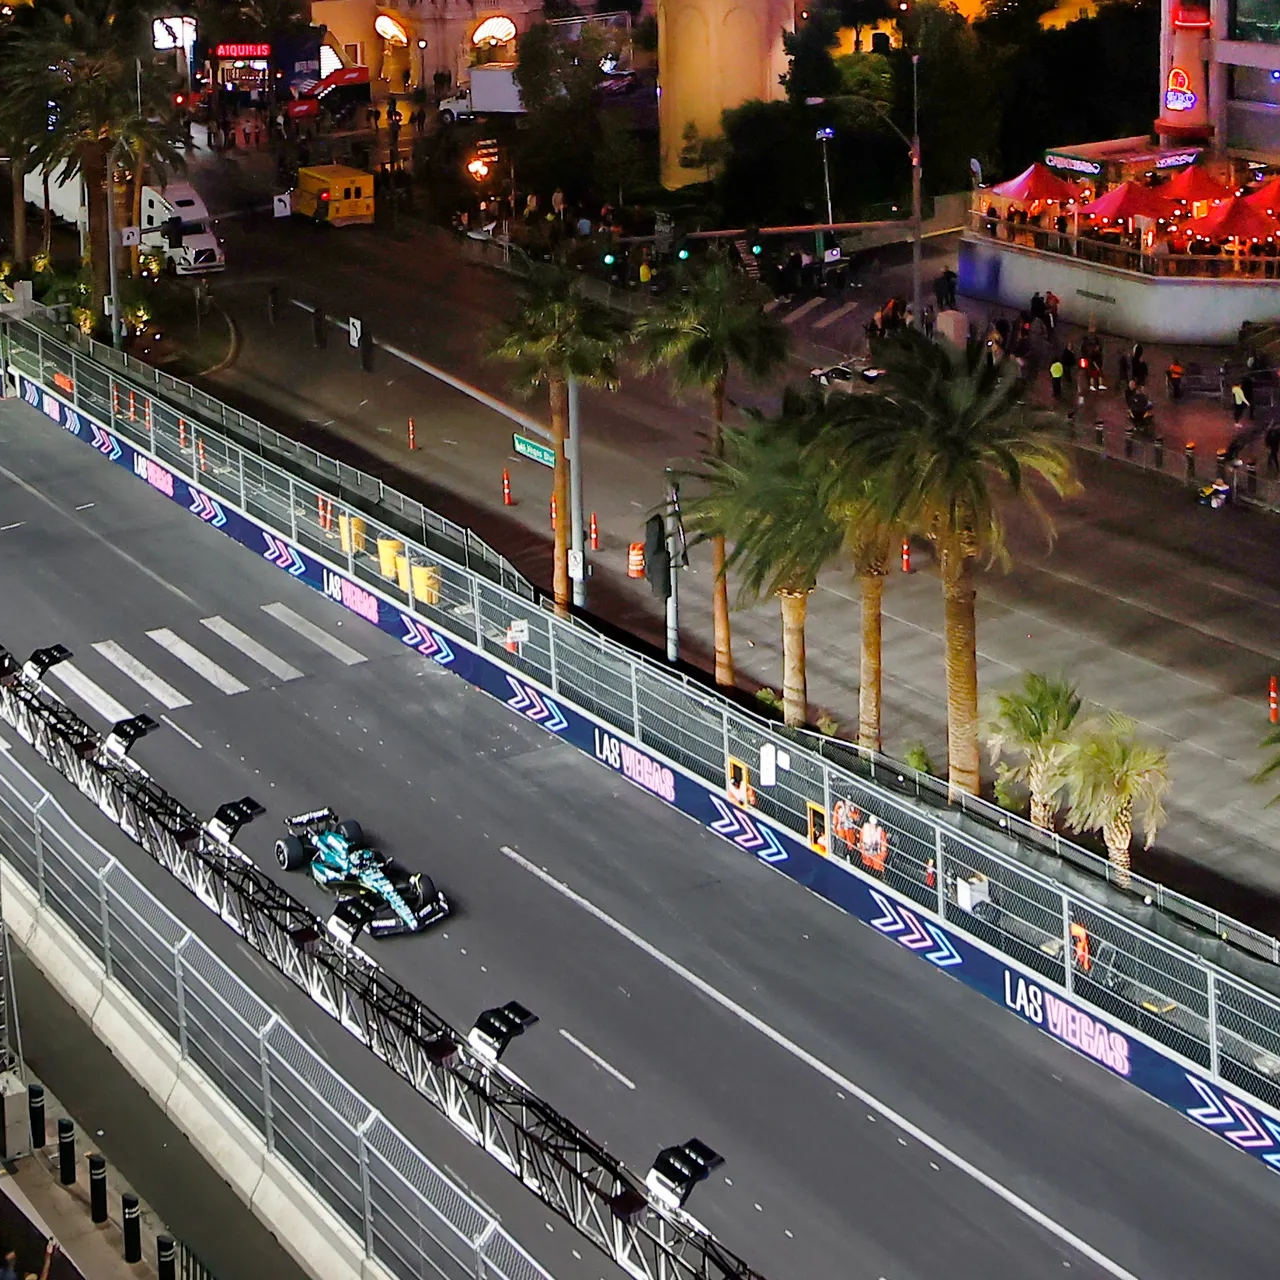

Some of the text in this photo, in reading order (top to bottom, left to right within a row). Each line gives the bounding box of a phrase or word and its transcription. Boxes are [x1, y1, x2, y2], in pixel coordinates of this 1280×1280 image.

[323, 568, 380, 624] LAS VEGAS
[593, 727, 677, 803] LAS VEGAS
[1004, 969, 1131, 1076] LAS VEGAS
